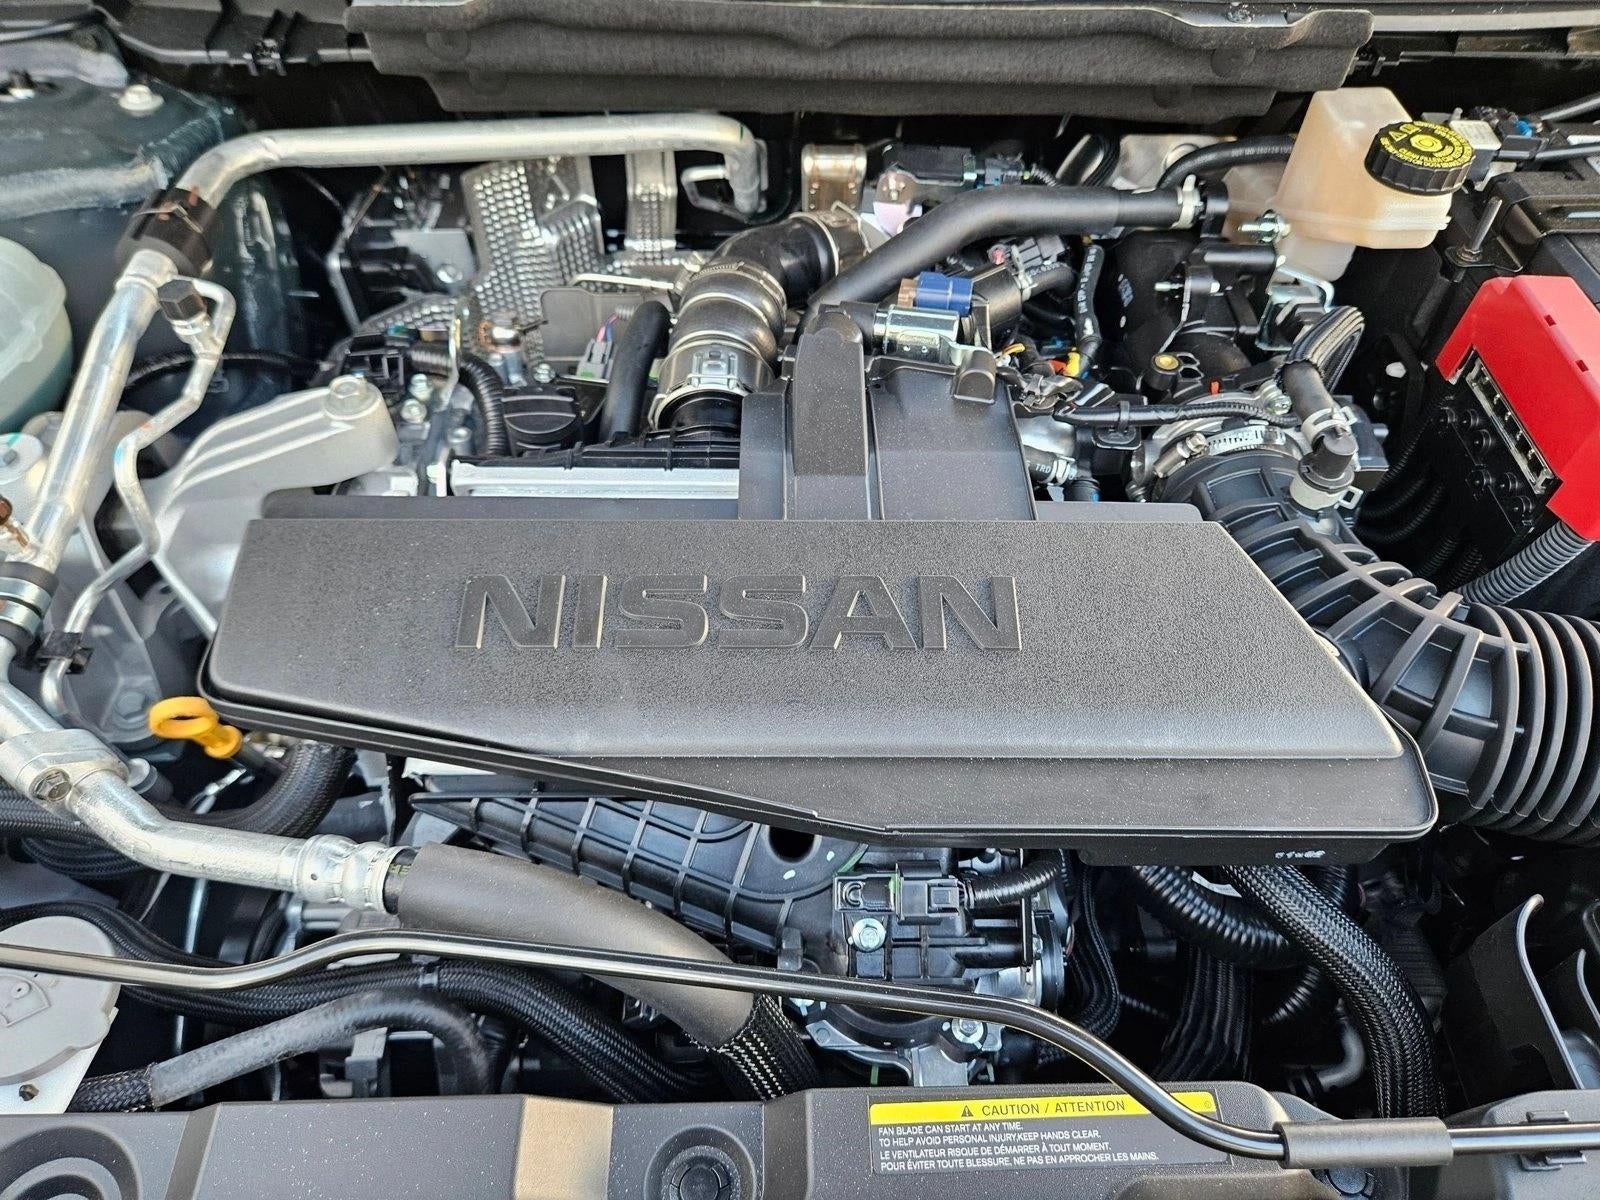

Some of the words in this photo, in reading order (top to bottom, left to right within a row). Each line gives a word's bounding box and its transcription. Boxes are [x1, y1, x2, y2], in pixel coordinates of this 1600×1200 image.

[455, 573, 1022, 651] NISSAN
[982, 1104, 1040, 1116] CAUTION
[1055, 1100, 1126, 1113] ATTENTION
[879, 1127, 895, 1136] FAN
[897, 1125, 924, 1135] BLADE
[925, 1124, 943, 1134] CAN
[945, 1123, 971, 1133] START
[973, 1123, 982, 1132] AT
[984, 1122, 1001, 1131] ANY
[879, 1138, 890, 1147] TO
[893, 1137, 913, 1146] HELP
[916, 1136, 941, 1145] AVOID
[943, 1135, 987, 1144] PERSONAL
[1040, 1131, 1070, 1139] HANDS
[880, 1151, 890, 1159] LE
[892, 1148, 945, 1159] VENTILATEUR
[947, 1147, 978, 1157] RISQUE
[981, 1147, 992, 1155] DE
[994, 1144, 1040, 1155] DÉMARRER
[1042, 1142, 1047, 1152] À
[1051, 1143, 1071, 1152] TOUT
[1073, 1142, 1112, 1151] MOMENT.
[881, 1161, 905, 1171] POUR
[907, 1158, 935, 1170] ÉVITER
[937, 1159, 964, 1167] TOUTE
[1014, 1157, 1026, 1165] NE
[1028, 1156, 1043, 1164] PAS
[1046, 1155, 1057, 1163] EN
[1058, 1153, 1110, 1163] APPROCHER
[1112, 1152, 1128, 1161] LES
[1130, 1152, 1159, 1160] MAINS.
